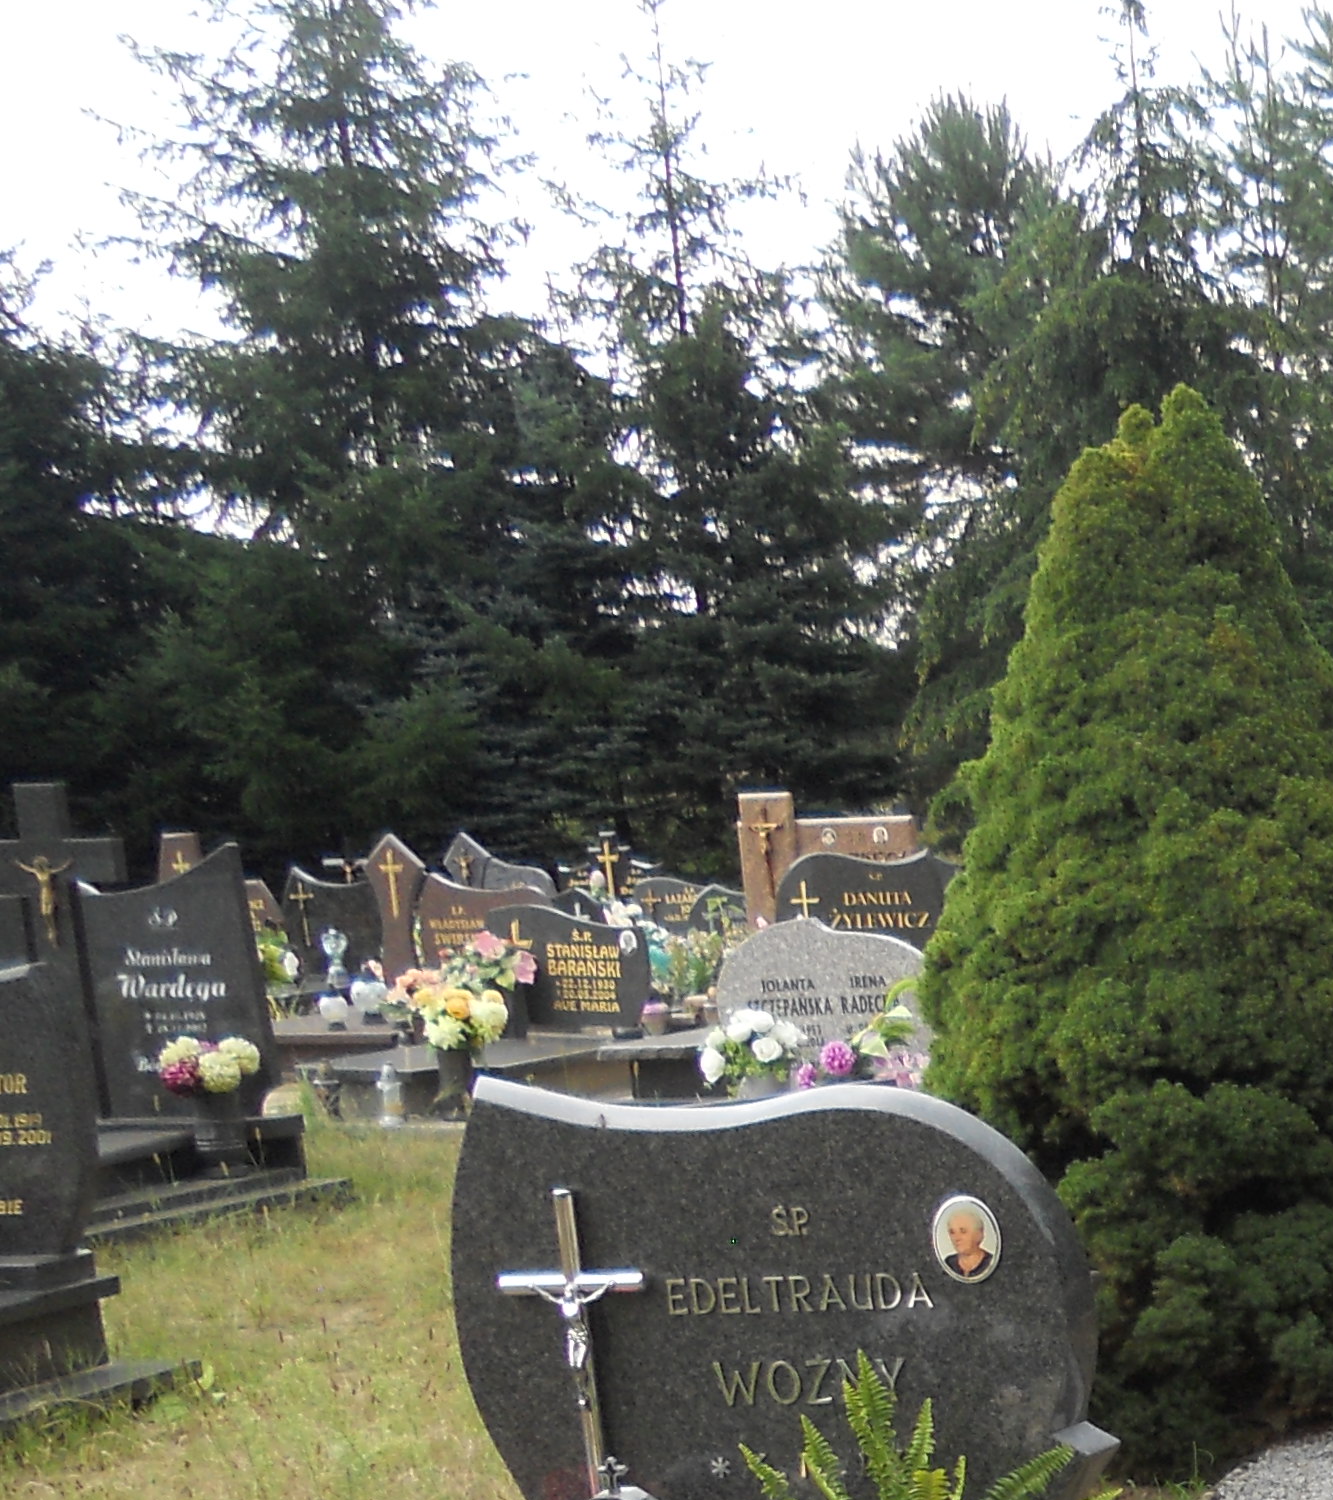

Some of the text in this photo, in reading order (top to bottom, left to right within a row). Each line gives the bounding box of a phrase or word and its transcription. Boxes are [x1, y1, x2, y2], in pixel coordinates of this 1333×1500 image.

[844, 891, 912, 906] DANUTA
[760, 975, 887, 993] JOLANTA IRENA
[581, 1001, 620, 1013] MARIA
[665, 1271, 935, 1317] EDELTRAUDA
